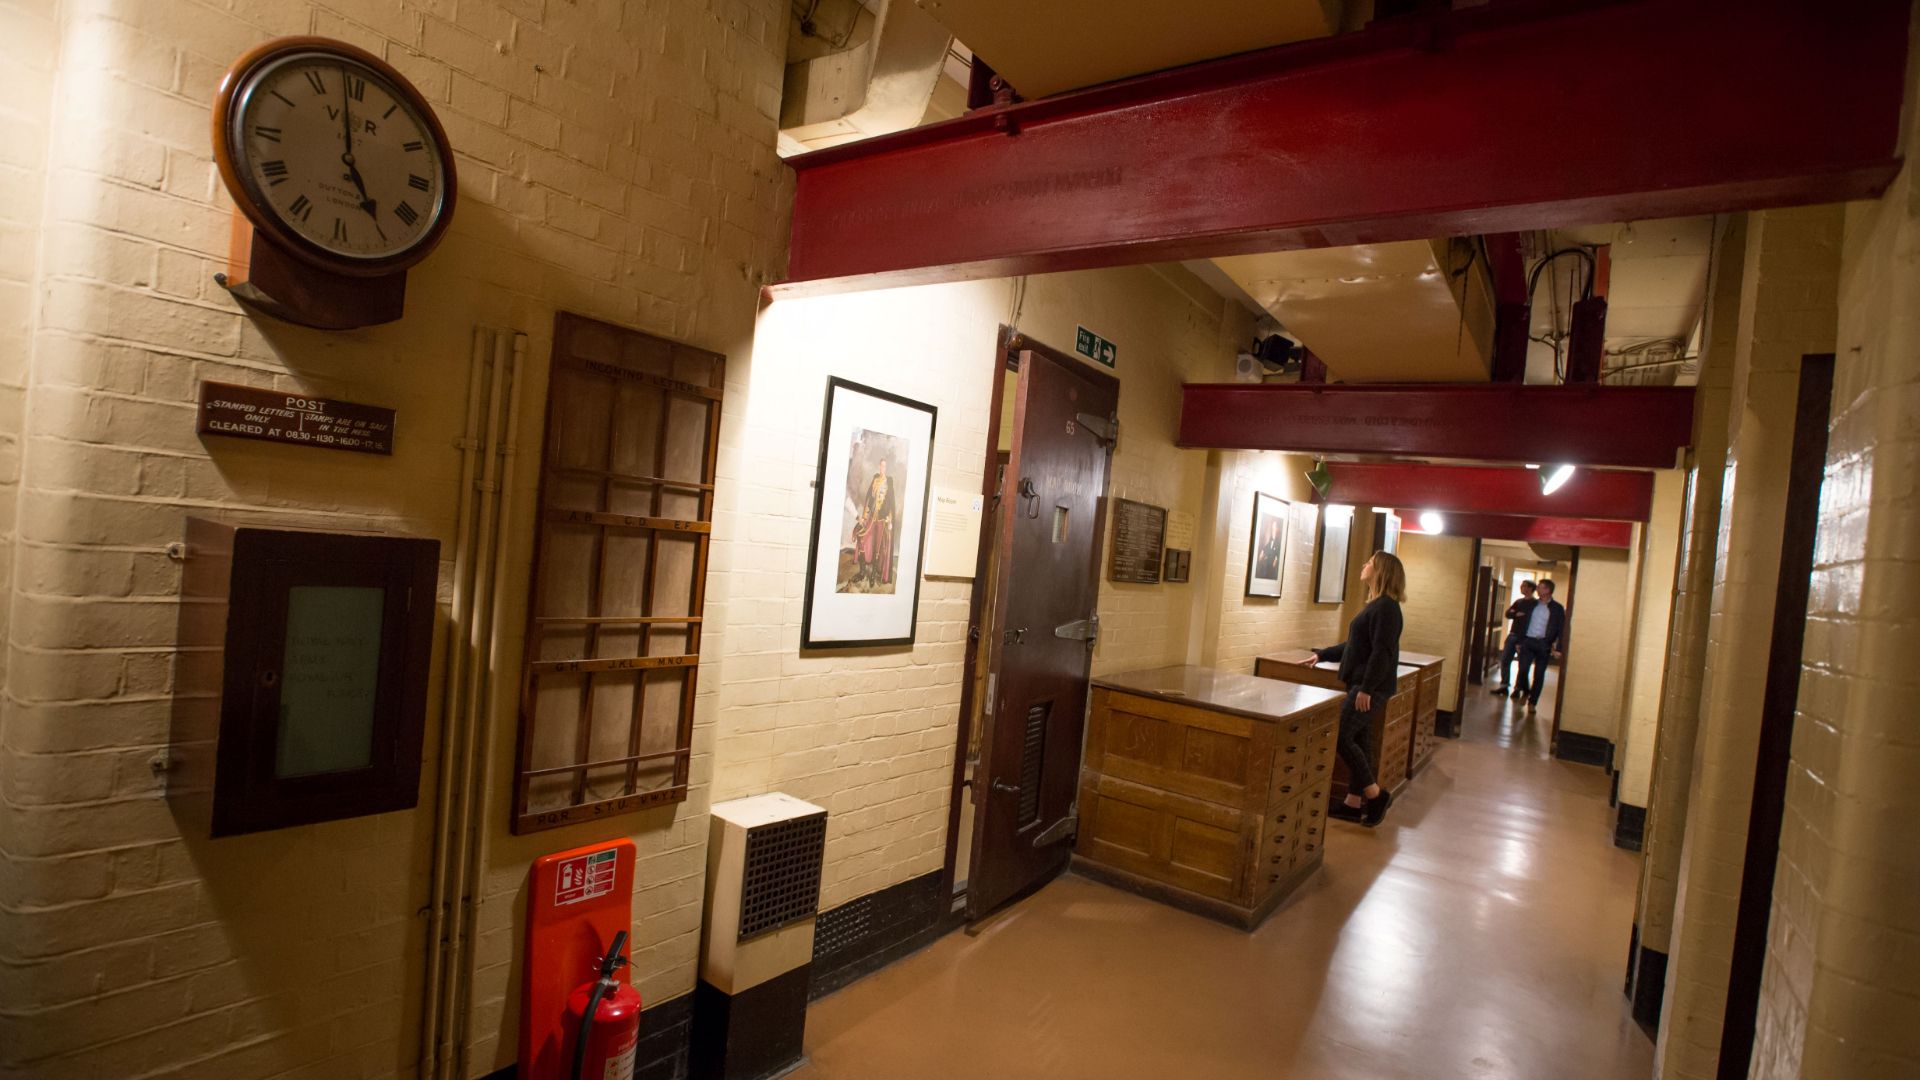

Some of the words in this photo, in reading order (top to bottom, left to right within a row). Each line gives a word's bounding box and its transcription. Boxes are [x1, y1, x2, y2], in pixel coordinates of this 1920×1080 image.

[1079, 330, 1090, 344] Fire
[585, 359, 644, 381] INCOMING
[652, 375, 700, 393] LETTERS
[213, 399, 257, 413] STAMPED
[259, 407, 295, 419] LETTERS
[286, 397, 326, 412] POST
[304, 413, 335, 424] STAMPS
[209, 420, 263, 435] CLEARED
[267, 428, 282, 437] AT
[333, 426, 350, 434] THE
[1065, 420, 1075, 436] 65
